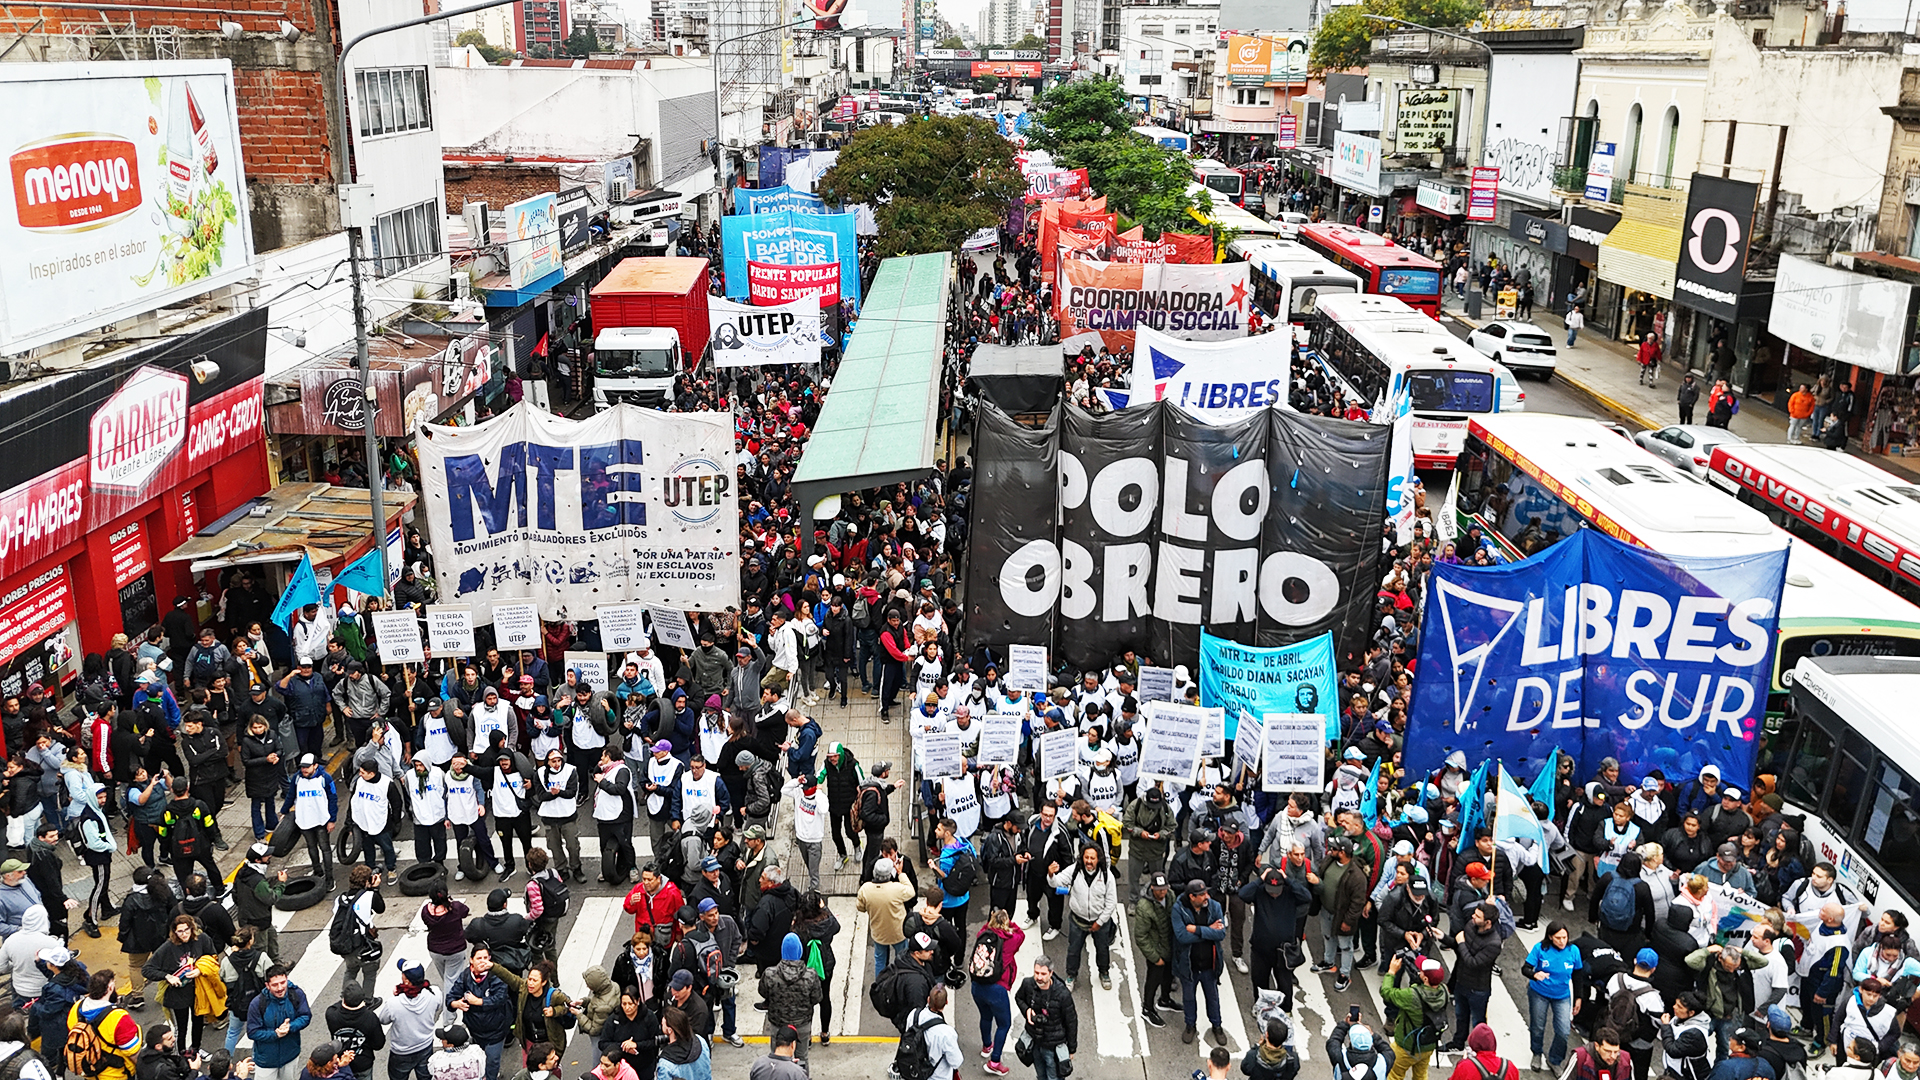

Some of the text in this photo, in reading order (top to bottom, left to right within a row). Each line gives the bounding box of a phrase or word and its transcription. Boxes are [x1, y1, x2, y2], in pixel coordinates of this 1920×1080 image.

[1241, 48, 1256, 59] IGI
[1028, 173, 1056, 197] FOL
[70, 204, 103, 218] DESDE 1948
[756, 239, 826, 256] BARRIOS
[757, 251, 828, 265] DE PIE
[29, 239, 148, 281] Inspirados en el sabor
[750, 265, 838, 283] FRENTE POPULAR
[752, 283, 778, 299] DARIO
[1070, 287, 1223, 312] COORDINADORA
[739, 312, 795, 337] UTEP
[1069, 308, 1239, 332] POR CAMBIO SOCIAL
[1076, 318, 1088, 330] EL
[1180, 379, 1280, 409] LIBRES
[322, 399, 383, 426] Andrs
[97, 386, 181, 472] CARNES
[188, 393, 260, 462] CARNES-CERDO
[110, 445, 167, 480] Vicente López
[443, 439, 648, 543] MTE
[663, 474, 730, 507] UTEP
[1058, 449, 1271, 542] POLO
[1724, 458, 1826, 524] OLIVOS
[1561, 488, 1594, 518] 59
[127, 521, 139, 536] DE:
[454, 529, 648, 556] MOVIMIENTO EXCLUIDOS
[636, 551, 726, 560] POR UNA PATRIA
[636, 562, 714, 570] SIN ESCLAVOS
[128, 560, 147, 578] PIZZAS
[636, 571, 716, 580] NI EXCLUIDOS!
[0, 564, 64, 609] JORES PRECIOS
[999, 537, 1340, 626] OBRERO
[14, 585, 68, 621] VINOS ALMACÉN
[23, 600, 63, 629] CONGELADOS
[1520, 583, 1776, 667] LIBRES
[392, 648, 410, 657] UTEP
[443, 641, 461, 649] UTEP
[614, 636, 631, 645] UTEP
[1219, 647, 1302, 667] MTR 12 DE ABRIL
[1247, 670, 1282, 684] DIANA
[1287, 664, 1325, 683] SACAYAN
[1221, 680, 1257, 701] TRABAJO
[1618, 669, 1756, 739] SUR
[480, 723, 501, 733] UTEP
[1120, 751, 1137, 761] POLO
[955, 794, 974, 804] POLO
[1093, 786, 1115, 794] POLO
[1821, 842, 1838, 866] 1205
